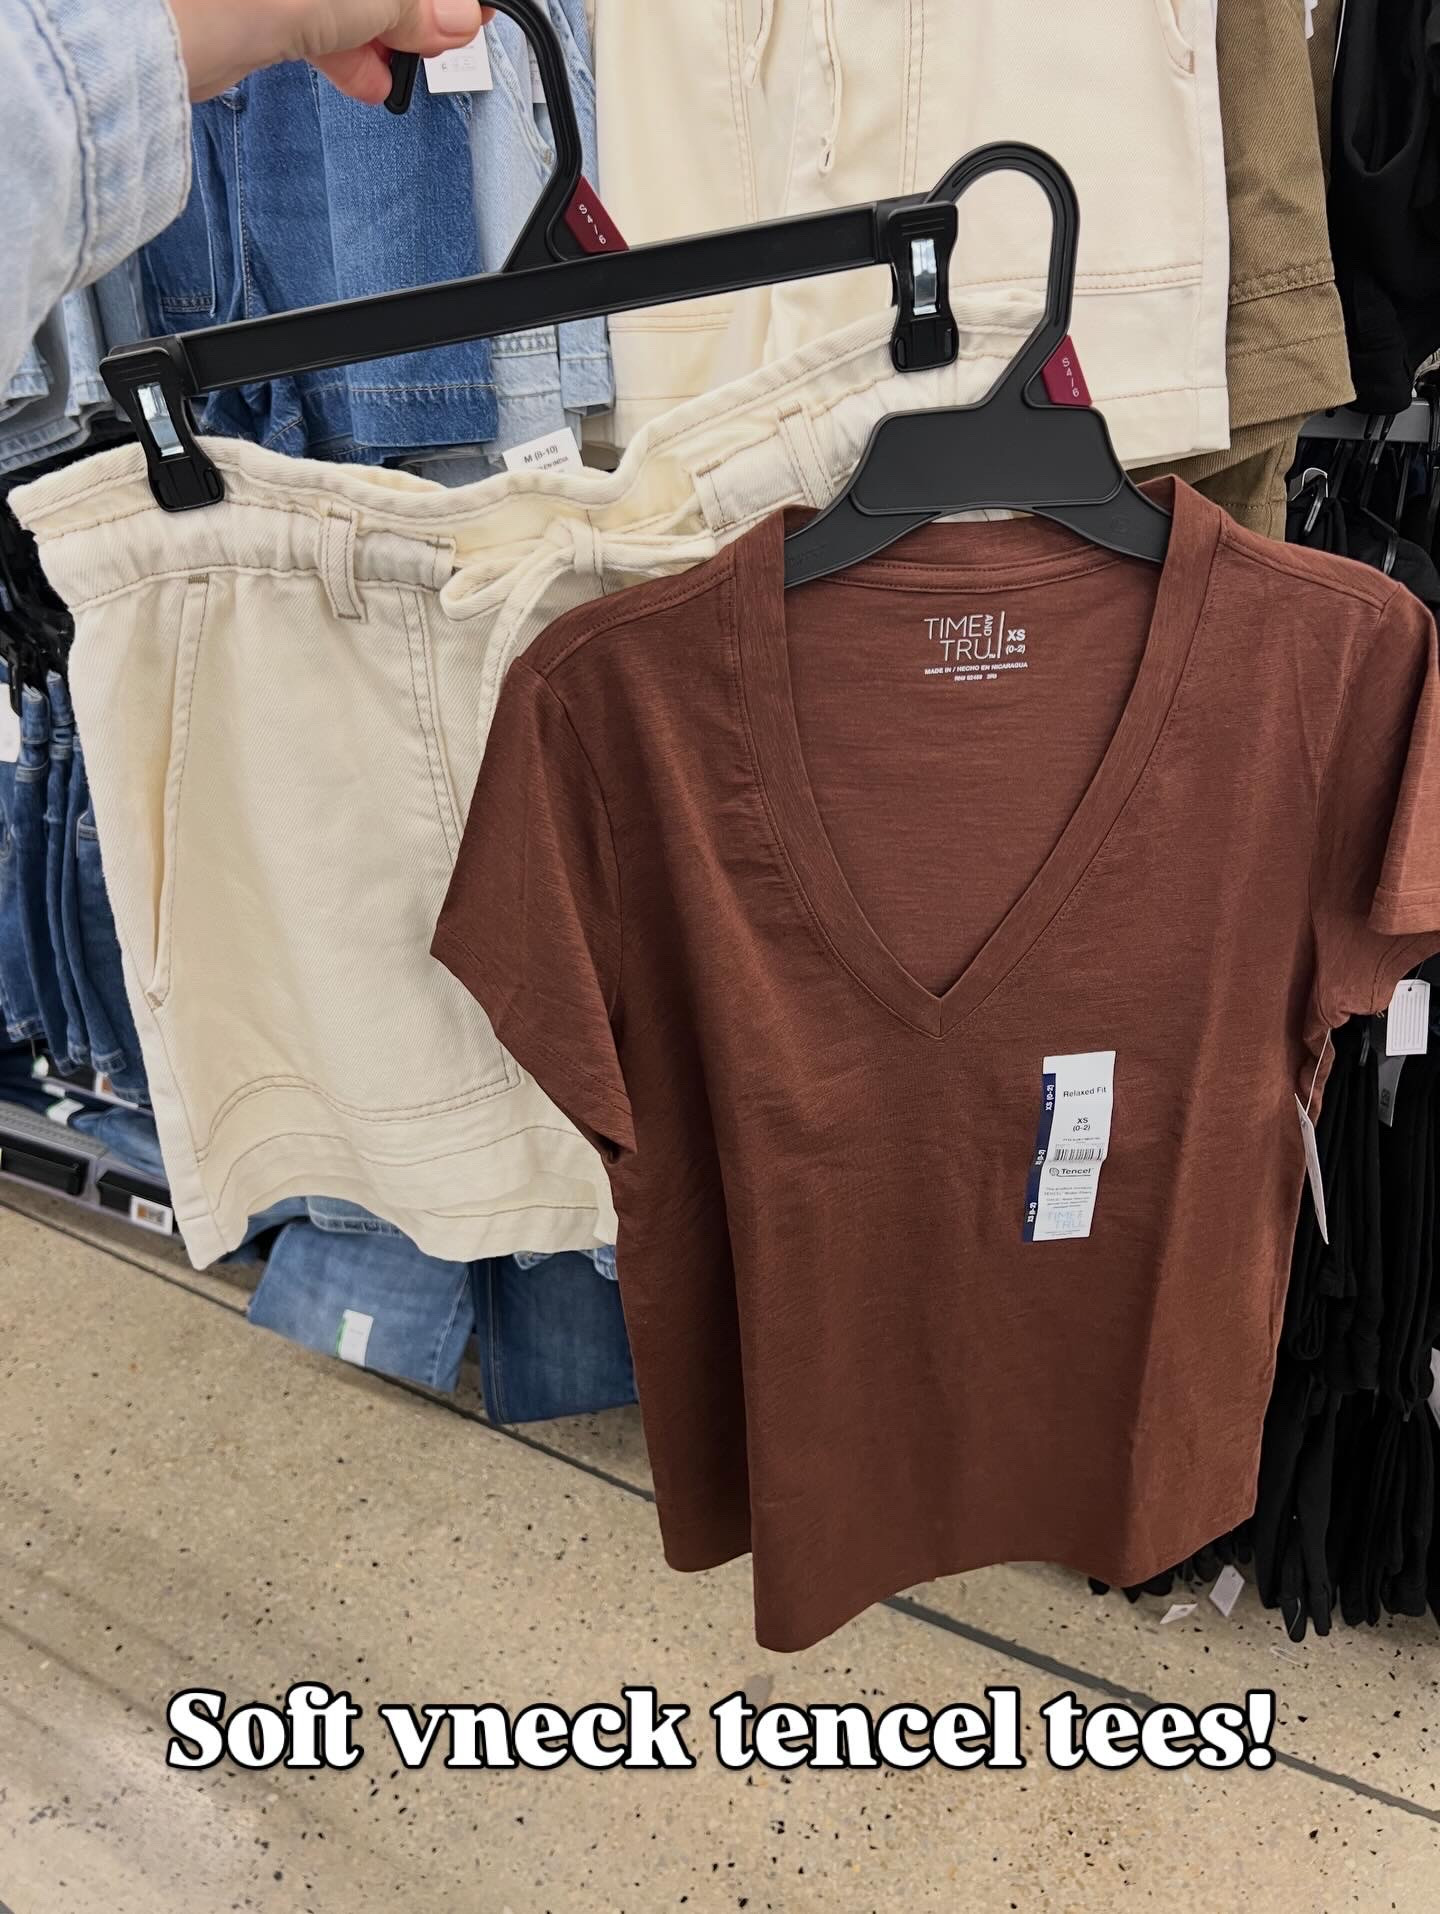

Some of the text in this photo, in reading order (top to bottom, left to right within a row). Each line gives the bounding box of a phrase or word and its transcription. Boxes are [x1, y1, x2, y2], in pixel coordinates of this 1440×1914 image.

[523, 454, 533, 463] M
[924, 614, 983, 640] TIME
[984, 614, 994, 637] AND
[1007, 629, 1026, 642] XS
[940, 637, 992, 661] TRU
[1005, 644, 1026, 655] (0-2)
[924, 667, 944, 675] MADE
[957, 664, 980, 672] HECHO
[980, 663, 990, 671] EN
[991, 661, 1028, 670] NICARAGUA
[1063, 1086, 1107, 1098] Relaxed Fit
[1072, 1124, 1091, 1132] (0-2)
